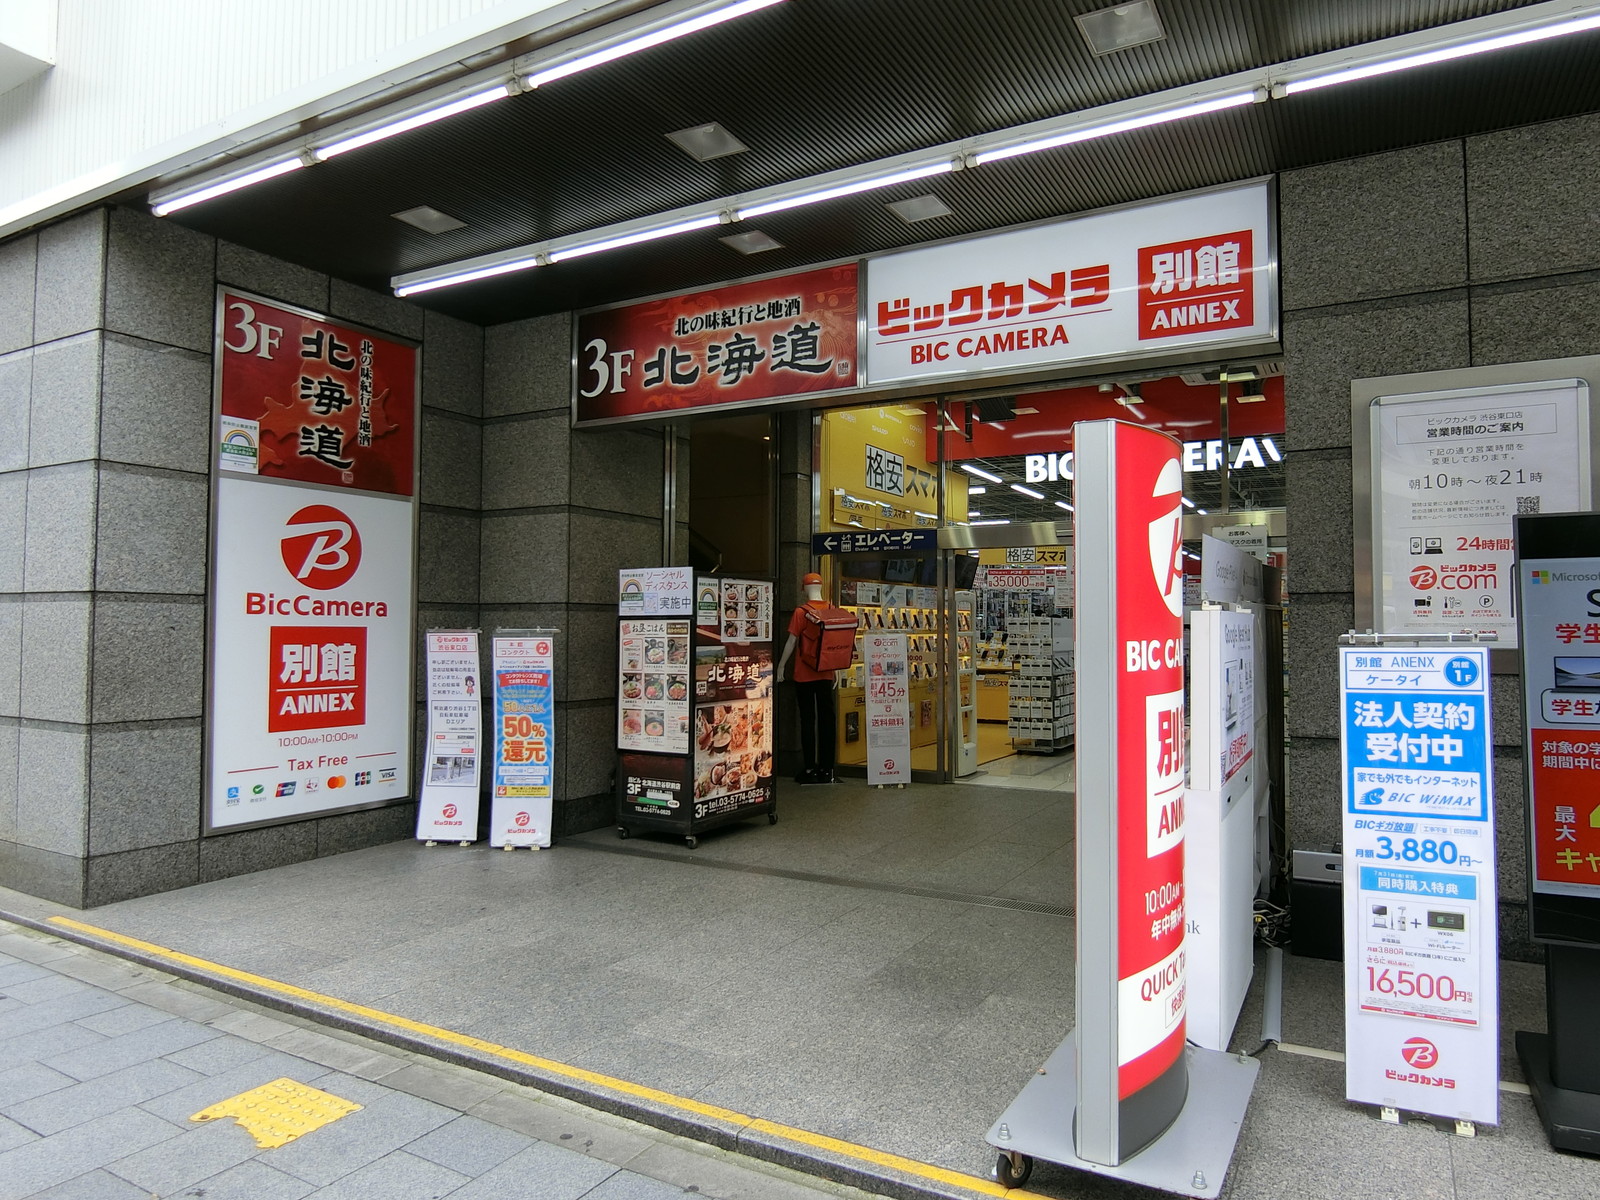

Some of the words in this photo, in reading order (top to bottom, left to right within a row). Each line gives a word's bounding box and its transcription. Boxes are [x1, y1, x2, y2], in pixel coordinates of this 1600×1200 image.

[1150, 241, 1240, 296] 別館
[877, 264, 1110, 336] ビックカメラ
[674, 296, 801, 336] 北の味紀行と地酒
[1151, 299, 1240, 331] ANNEX
[225, 303, 283, 359] 3F
[644, 321, 834, 388] 北海道
[911, 341, 950, 365] BIC
[957, 324, 1069, 357] CAMERA
[580, 338, 635, 398] 3F
[299, 329, 356, 469] 北海道
[359, 339, 374, 447] 北の味紀行と地酒
[1427, 414, 1477, 425] ビックカメラ
[1480, 411, 1523, 421] 渋谷東口店
[1427, 421, 1524, 438] 営業時間のご案内
[1427, 443, 1524, 457] 下記の通り営業時間を
[1431, 454, 1516, 465] 変更しております。
[855, 531, 924, 546] エレベーター
[646, 570, 684, 580] ソーシャル
[1440, 563, 1496, 572] ビックカメラ
[645, 581, 689, 591] ディスタンス
[246, 592, 388, 617] BicCamera
[660, 596, 691, 610] 実施中
[280, 643, 356, 684] 別館
[1126, 640, 1161, 672] BIC
[1355, 657, 1382, 668] 別館
[1391, 656, 1435, 668] ANENX
[1452, 661, 1470, 669] 別館
[708, 663, 762, 684] 北海道
[1366, 674, 1422, 686] ケータイ
[1454, 670, 1472, 682] 1F
[878, 682, 905, 697] 45分
[280, 693, 355, 715] ANNEX
[872, 718, 904, 726] 送料無料
[1353, 700, 1475, 730] 法人契約
[504, 715, 546, 737] 50%
[503, 740, 546, 763] 還元
[1366, 732, 1463, 764] 受付中
[288, 758, 313, 772] Tax
[319, 755, 348, 768] Free
[627, 784, 641, 795] 3F
[1357, 772, 1477, 787] 家でも外でもインターネット
[1387, 792, 1415, 803] BIC
[1420, 794, 1476, 806] WiMAX
[694, 804, 708, 818] 3F
[1554, 806, 1577, 842] 最大
[1378, 877, 1459, 895] 同時購入特典
[1141, 958, 1178, 1002] QUICK
[1385, 1069, 1455, 1089] ビックカメラ
